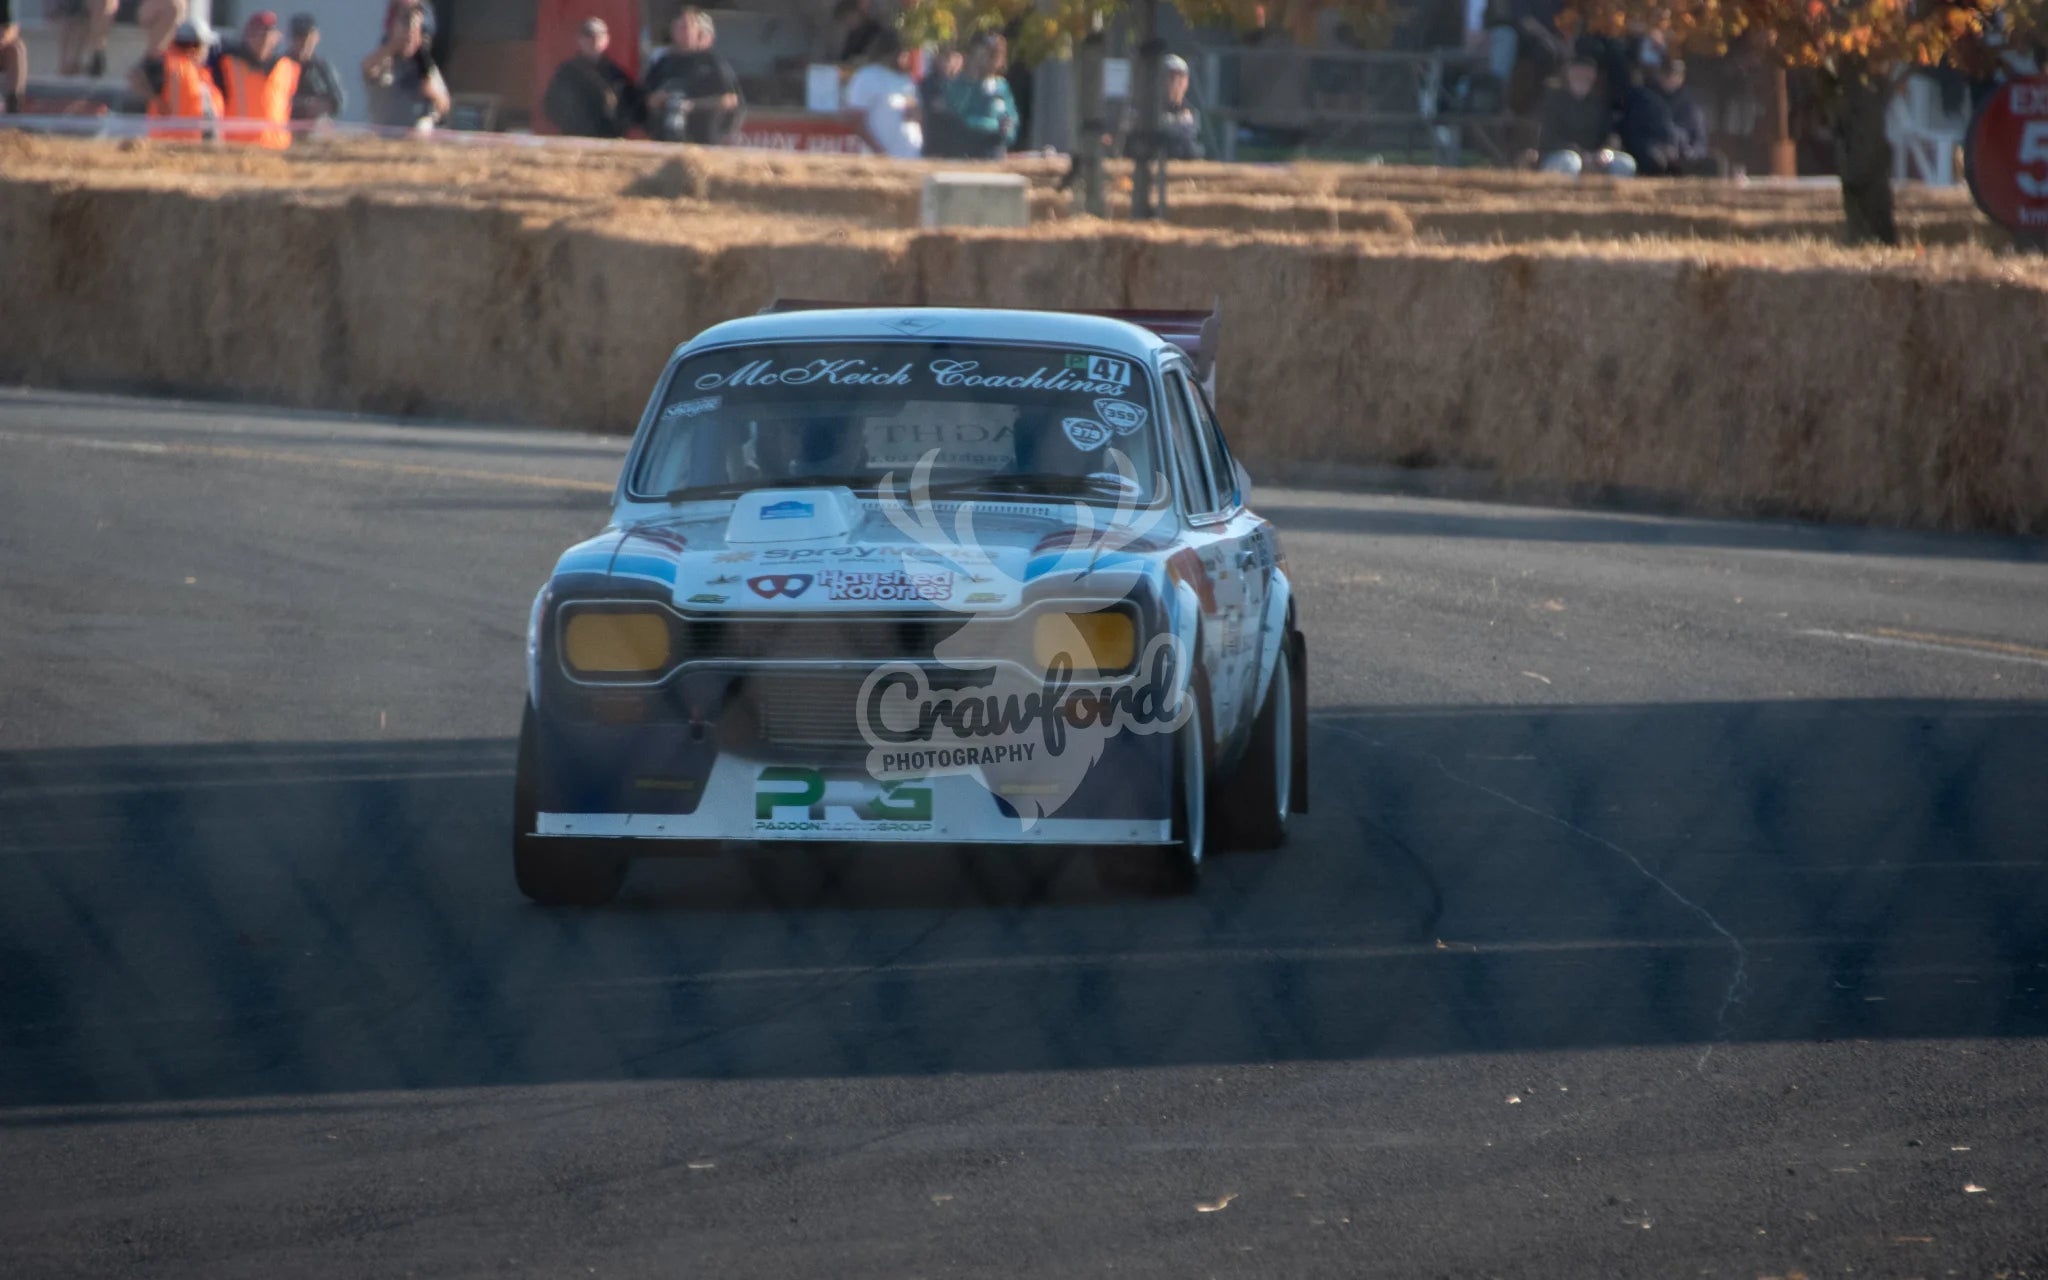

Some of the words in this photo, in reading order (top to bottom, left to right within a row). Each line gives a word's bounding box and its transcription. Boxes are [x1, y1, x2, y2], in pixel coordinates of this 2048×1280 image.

[695, 358, 913, 390] McKeich
[929, 359, 1126, 396] Coachlines
[1093, 358, 1126, 382] 47
[1105, 408, 1136, 421] 359
[818, 569, 954, 588] Hayshed
